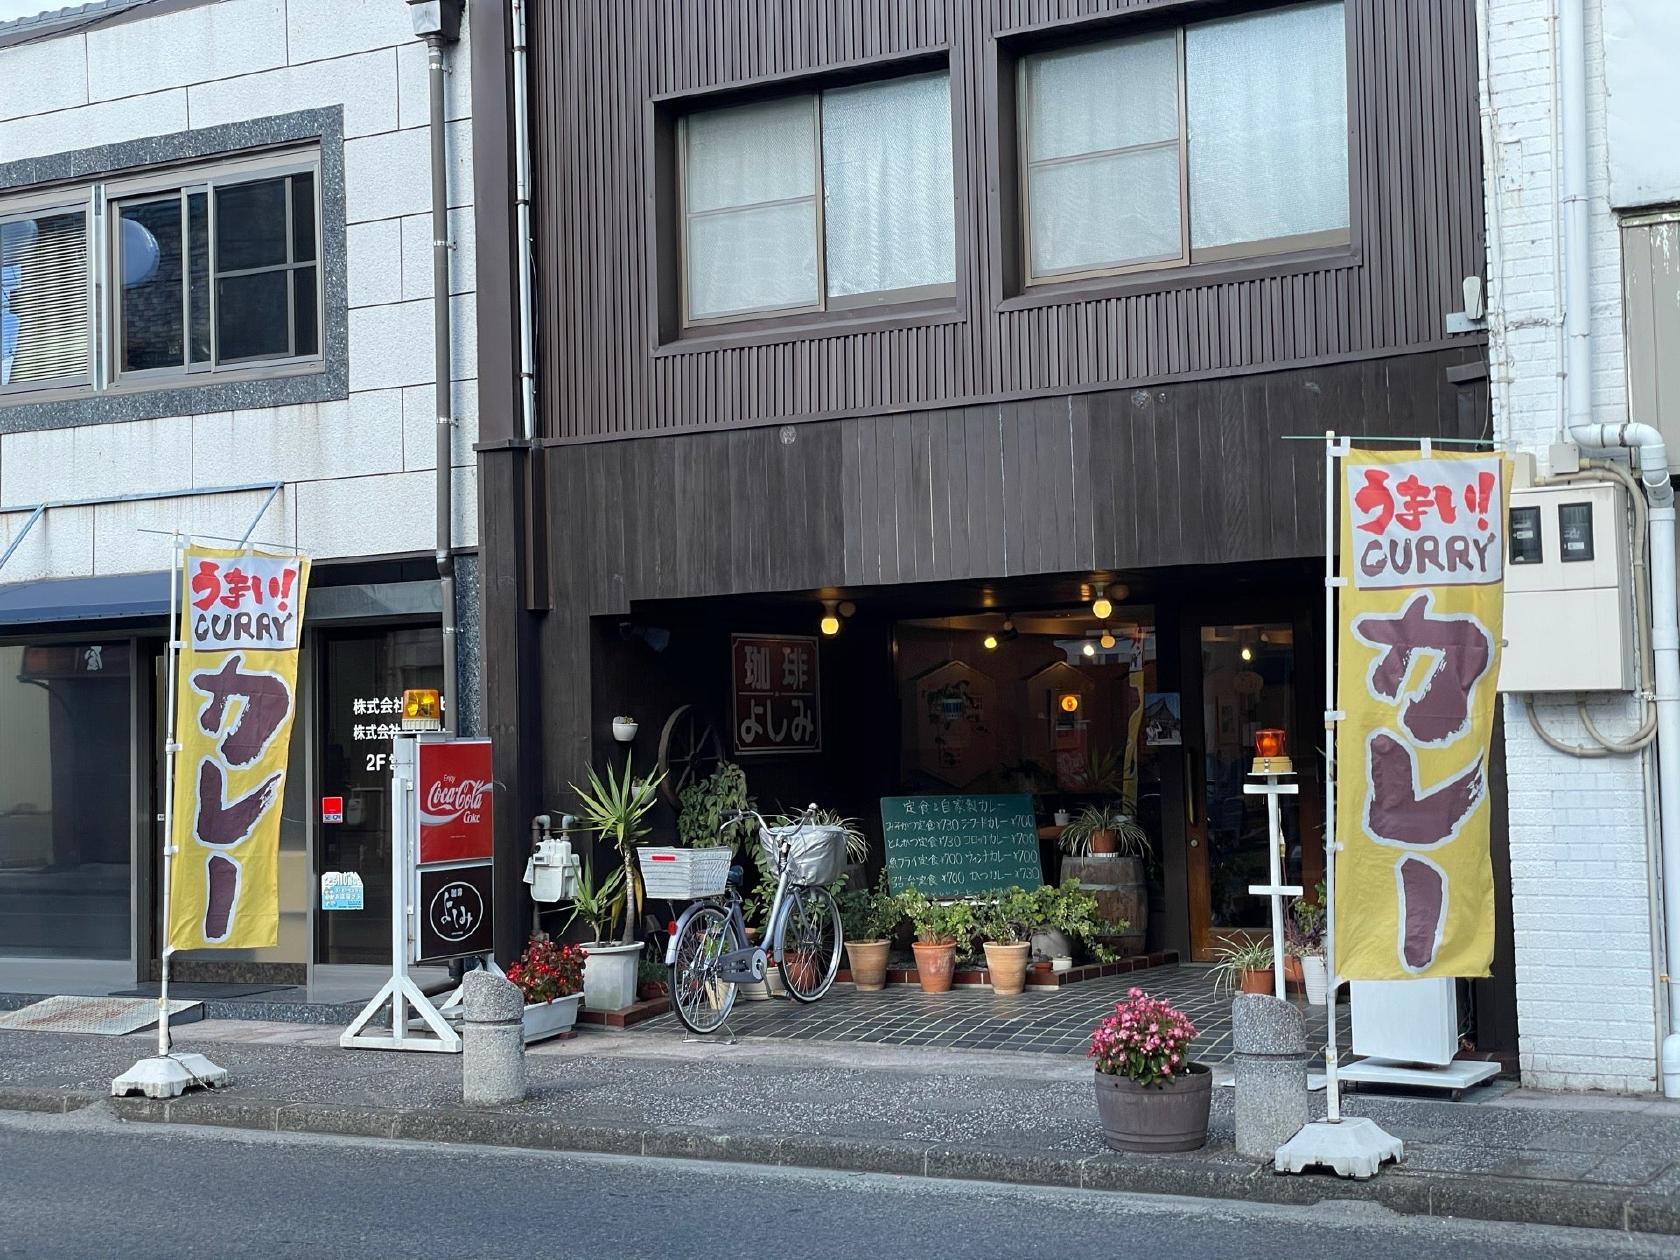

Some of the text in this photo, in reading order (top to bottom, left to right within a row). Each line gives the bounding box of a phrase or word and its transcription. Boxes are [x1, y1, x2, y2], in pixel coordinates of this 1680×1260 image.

[1354, 469, 1495, 534] うまい!
[1360, 532, 1496, 577] CURRY
[191, 561, 297, 612] うまい!
[194, 611, 293, 642] CURRY
[744, 645, 809, 690] 珈琲
[741, 698, 814, 744] よしみ
[192, 653, 291, 941] カレー
[427, 780, 485, 811] Coca-Cola
[1355, 592, 1492, 970] カレー
[463, 811, 481, 824] Coke
[441, 891, 473, 930] よしみ
